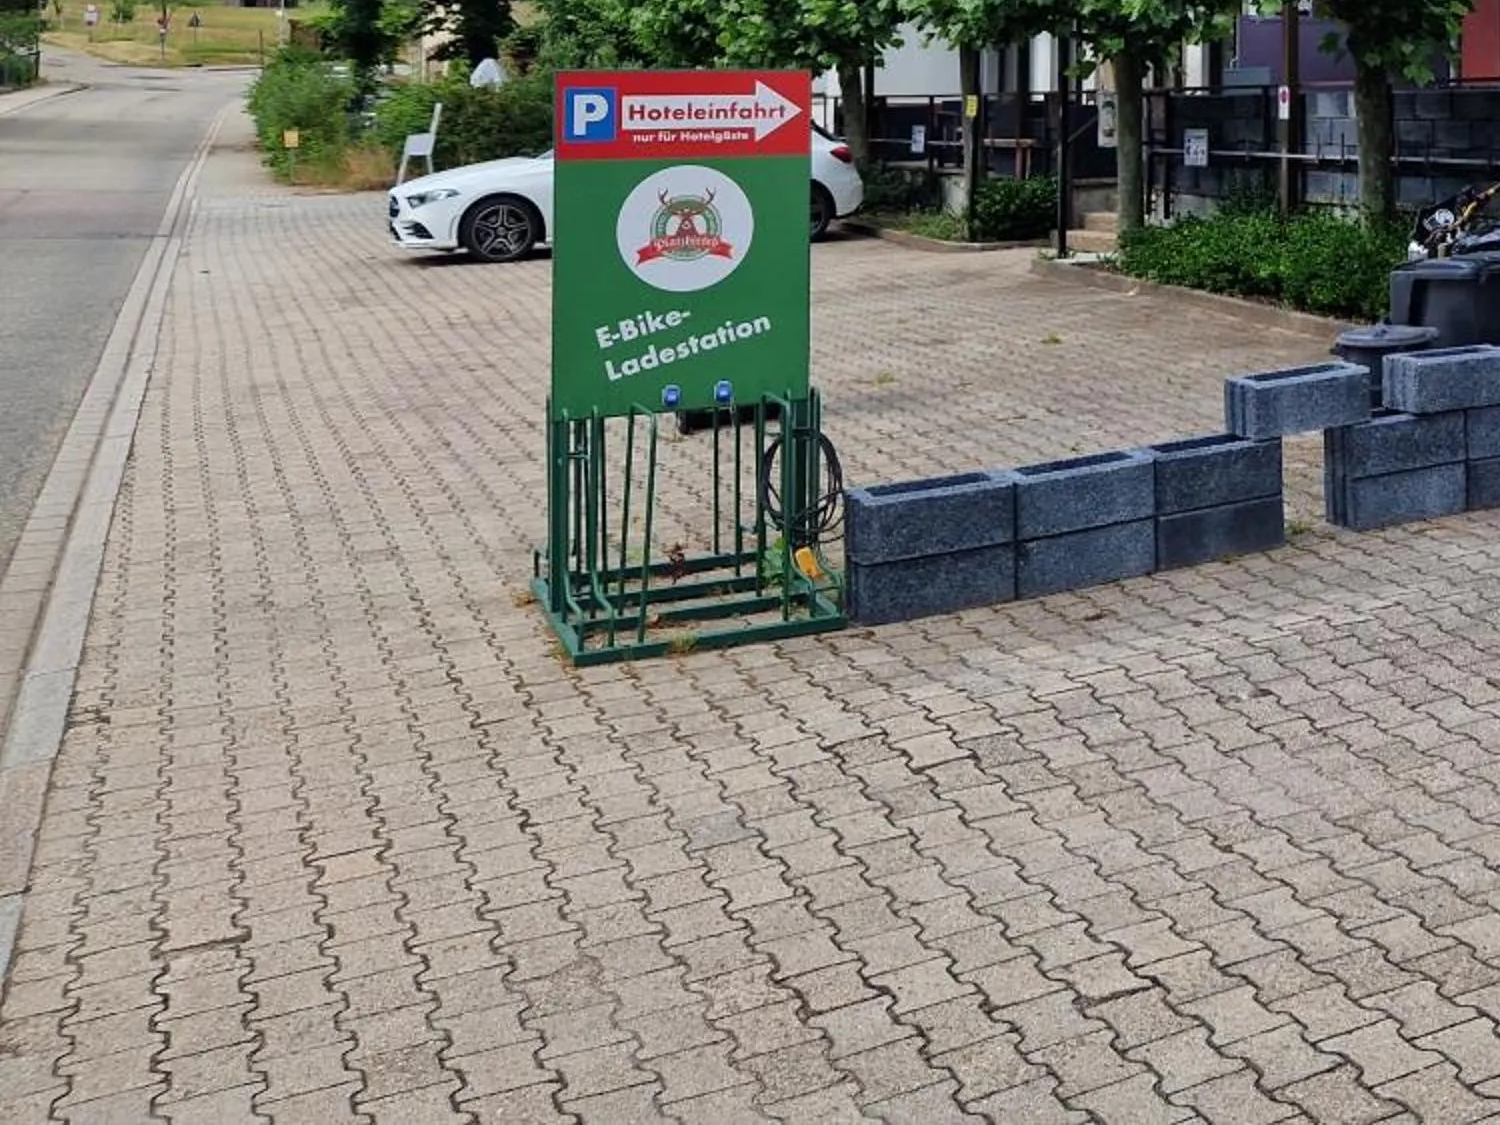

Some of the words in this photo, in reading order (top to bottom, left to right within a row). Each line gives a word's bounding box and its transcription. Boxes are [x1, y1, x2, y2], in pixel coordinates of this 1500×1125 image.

[573, 94, 609, 136] P
[628, 100, 786, 121] Hoteleinfahrt
[633, 133, 657, 143] nur
[658, 131, 677, 142] für
[680, 130, 749, 144] Hotelgäste
[595, 309, 692, 349] E-Bike-
[604, 315, 772, 382] Ladestation
